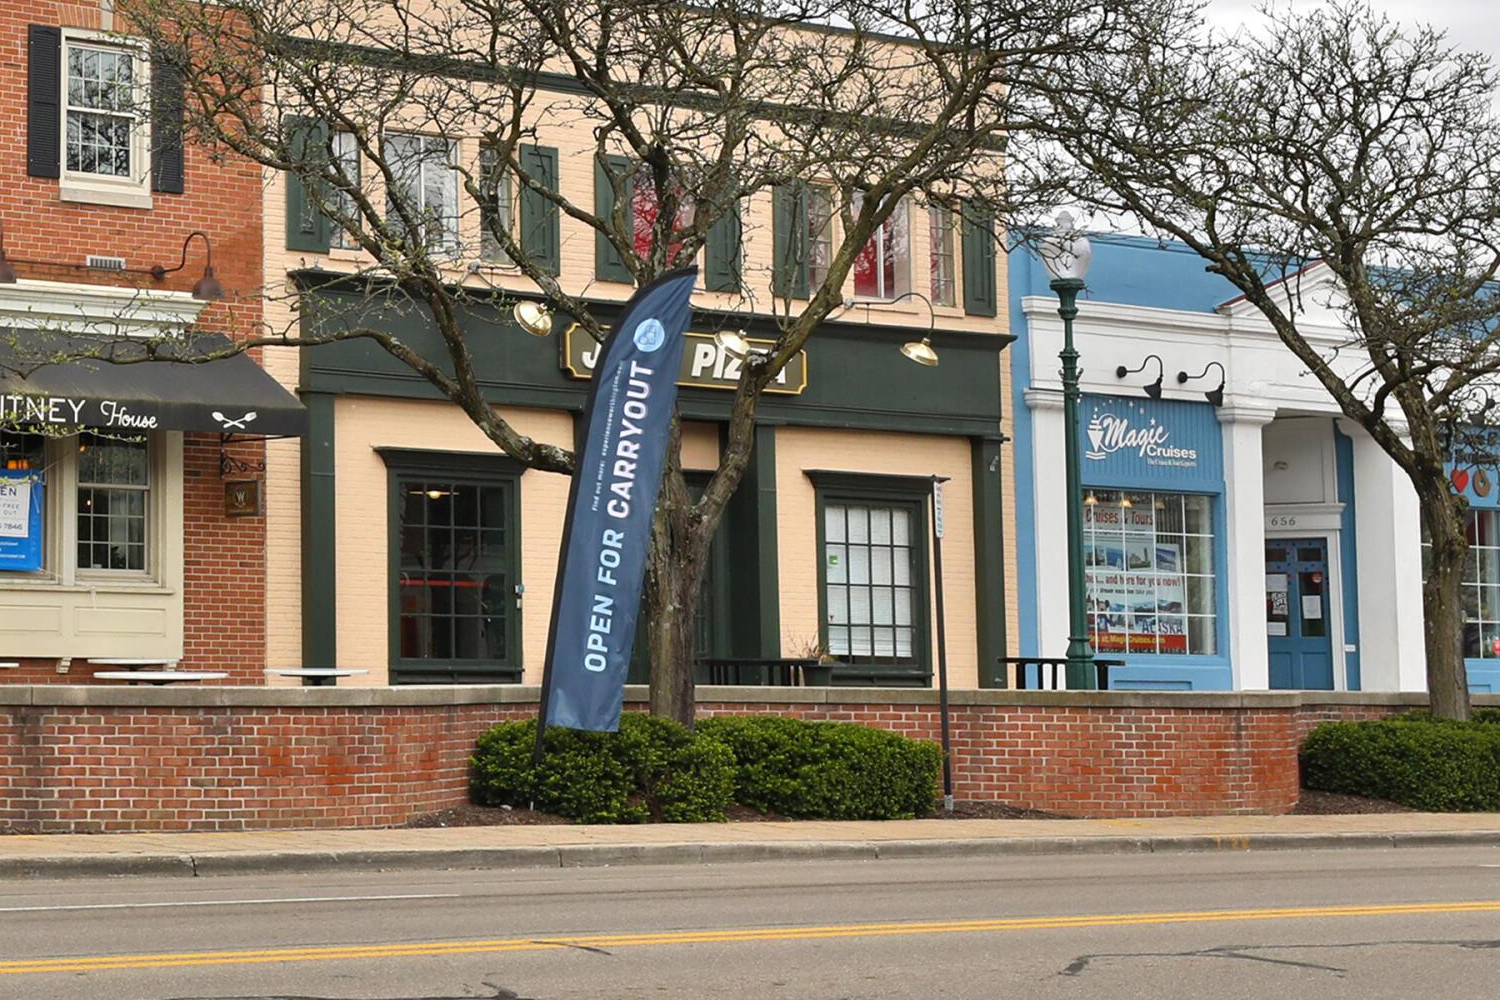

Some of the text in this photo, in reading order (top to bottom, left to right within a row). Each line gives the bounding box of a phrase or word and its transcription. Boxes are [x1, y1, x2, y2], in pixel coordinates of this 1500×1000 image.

[100, 400, 158, 430] House
[1102, 417, 1171, 458] Magic
[1146, 444, 1197, 459] Cruises
[584, 360, 654, 673] OPEN FOR CARRYOUT
[1086, 508, 1119, 524] Cruises
[1131, 511, 1153, 526] Tours
[1271, 516, 1296, 527] 656
